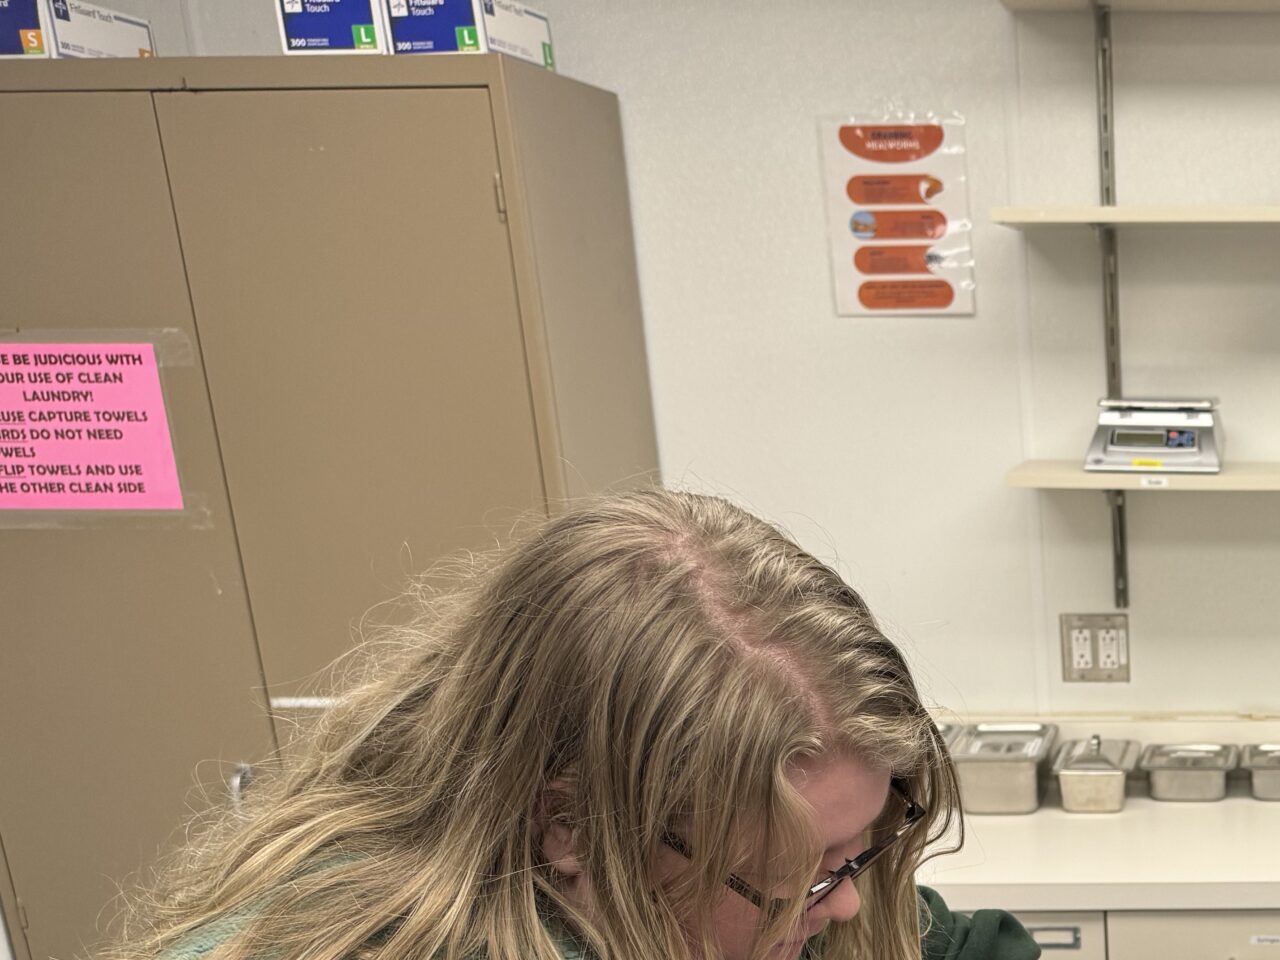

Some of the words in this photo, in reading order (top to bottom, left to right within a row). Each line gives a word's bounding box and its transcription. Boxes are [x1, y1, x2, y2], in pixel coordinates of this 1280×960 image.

[305, 4, 330, 13] Touch
[411, 7, 434, 16] Touch
[27, 32, 38, 47] S
[360, 27, 371, 42] L
[463, 29, 474, 45] L
[290, 38, 306, 47] 300
[397, 42, 412, 51] 300
[12, 354, 31, 366] BE
[34, 354, 102, 367] JUDICIOUS
[106, 354, 143, 366] WITH
[0, 372, 25, 384] OUR
[28, 372, 52, 384] USE
[55, 372, 74, 384] OF
[78, 372, 124, 384] CLEAN
[23, 390, 94, 403] LAUNDRY!
[0, 411, 25, 423] USE
[28, 411, 91, 423] CAPTURE
[94, 411, 148, 423] TOWELS
[0, 429, 27, 441] RDS
[30, 429, 50, 441] DO
[55, 429, 83, 441] NOT
[87, 429, 123, 441] NEED
[0, 447, 36, 458] WELS
[28, 465, 82, 476] TOWELS
[86, 465, 115, 476] AND
[119, 465, 143, 476] USE
[0, 483, 17, 494] HE
[20, 483, 65, 494] OTHER
[69, 483, 114, 494] CLEAN
[117, 483, 146, 494] SIDE
